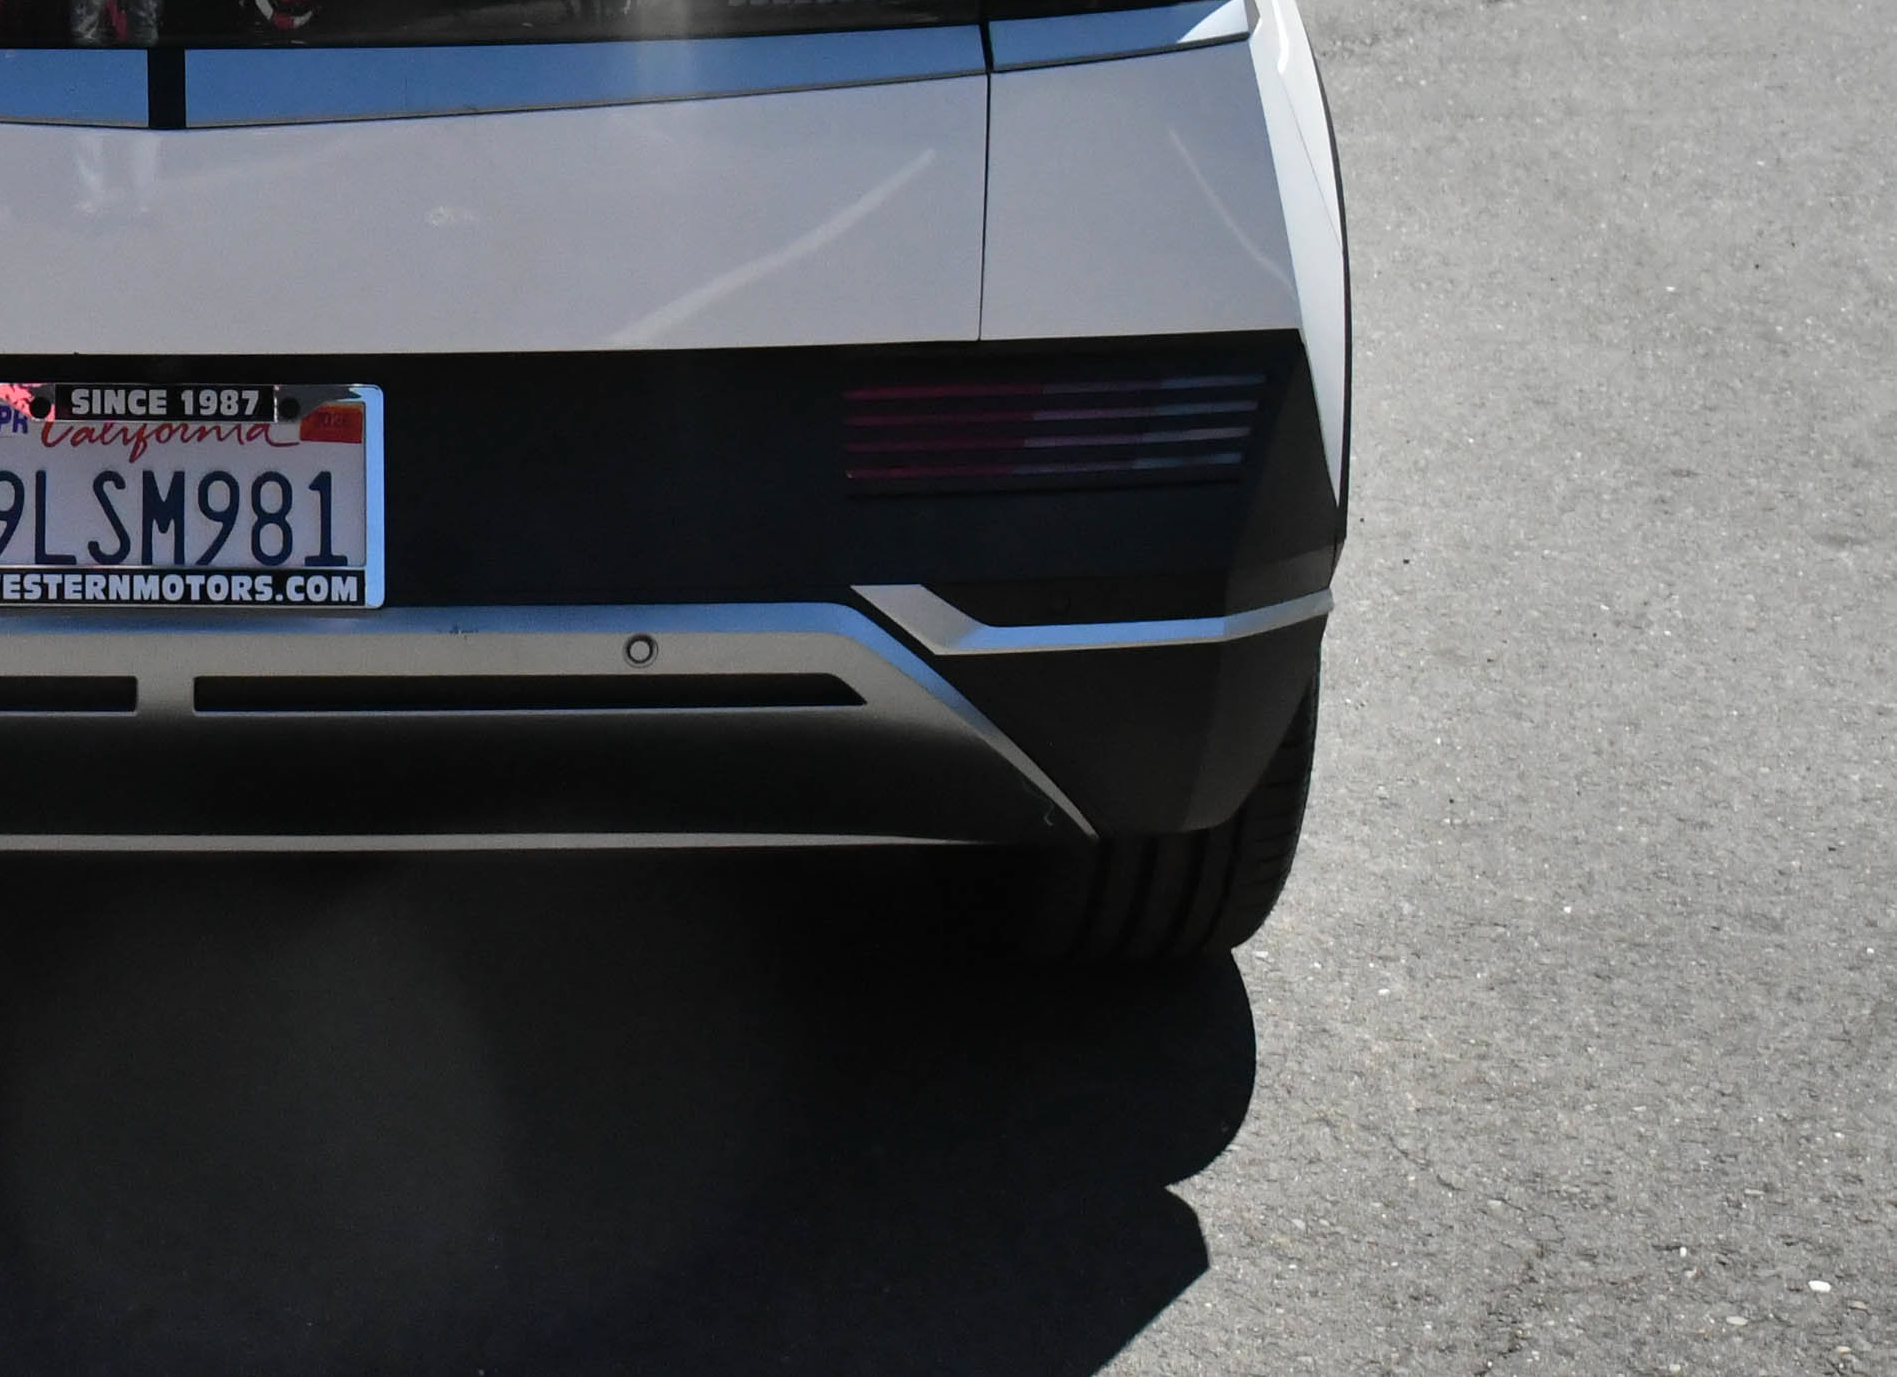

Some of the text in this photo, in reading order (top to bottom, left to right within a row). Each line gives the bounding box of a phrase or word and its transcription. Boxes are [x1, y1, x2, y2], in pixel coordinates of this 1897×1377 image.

[70, 388, 260, 416] SINCE 1987
[41, 421, 301, 463] California
